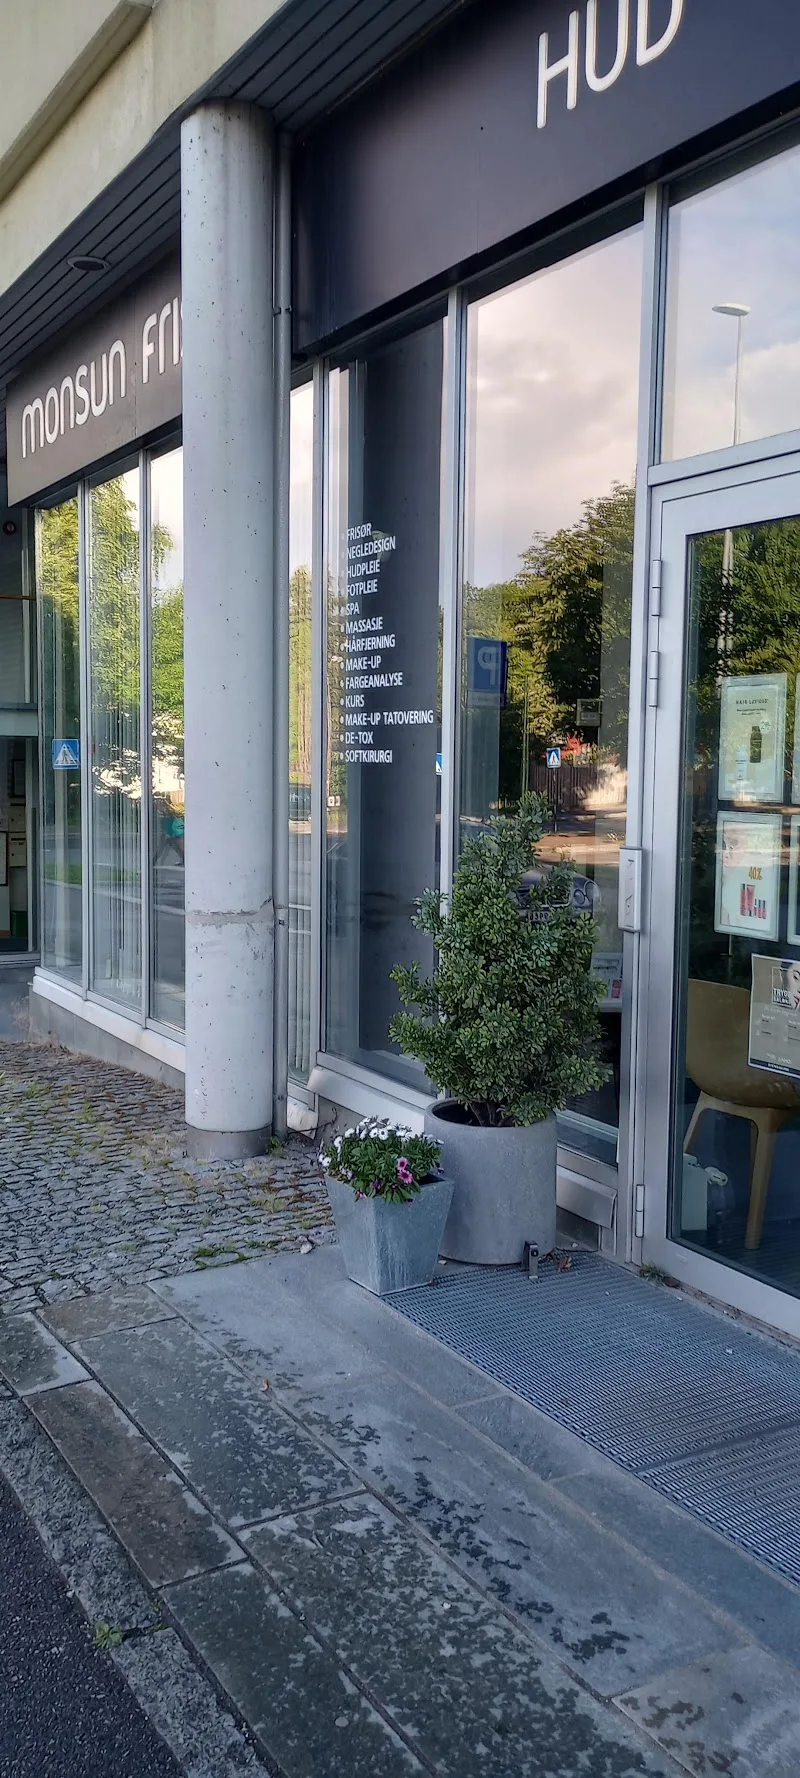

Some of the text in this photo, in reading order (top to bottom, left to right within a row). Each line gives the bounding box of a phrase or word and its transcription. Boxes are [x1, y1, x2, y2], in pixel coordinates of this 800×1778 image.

[536, 0, 683, 129] HUD
[346, 522, 372, 541] FRISØR
[346, 535, 396, 560] NEGLEDESIGN
[346, 559, 380, 580] HUDPLEIE
[346, 578, 378, 597] FOTPLEIE
[346, 602, 360, 616] SPA
[345, 617, 383, 635] MASSASJE
[345, 634, 396, 653] HÅRFJERNING
[345, 656, 381, 672] MAKE-UP
[345, 672, 403, 690] FARGEANALYSE
[345, 694, 364, 708] KURS
[345, 709, 434, 727] MAKE-UP TATOVERING
[345, 731, 374, 745] DE-TOX
[345, 749, 393, 764] SOFTKIRURGI
